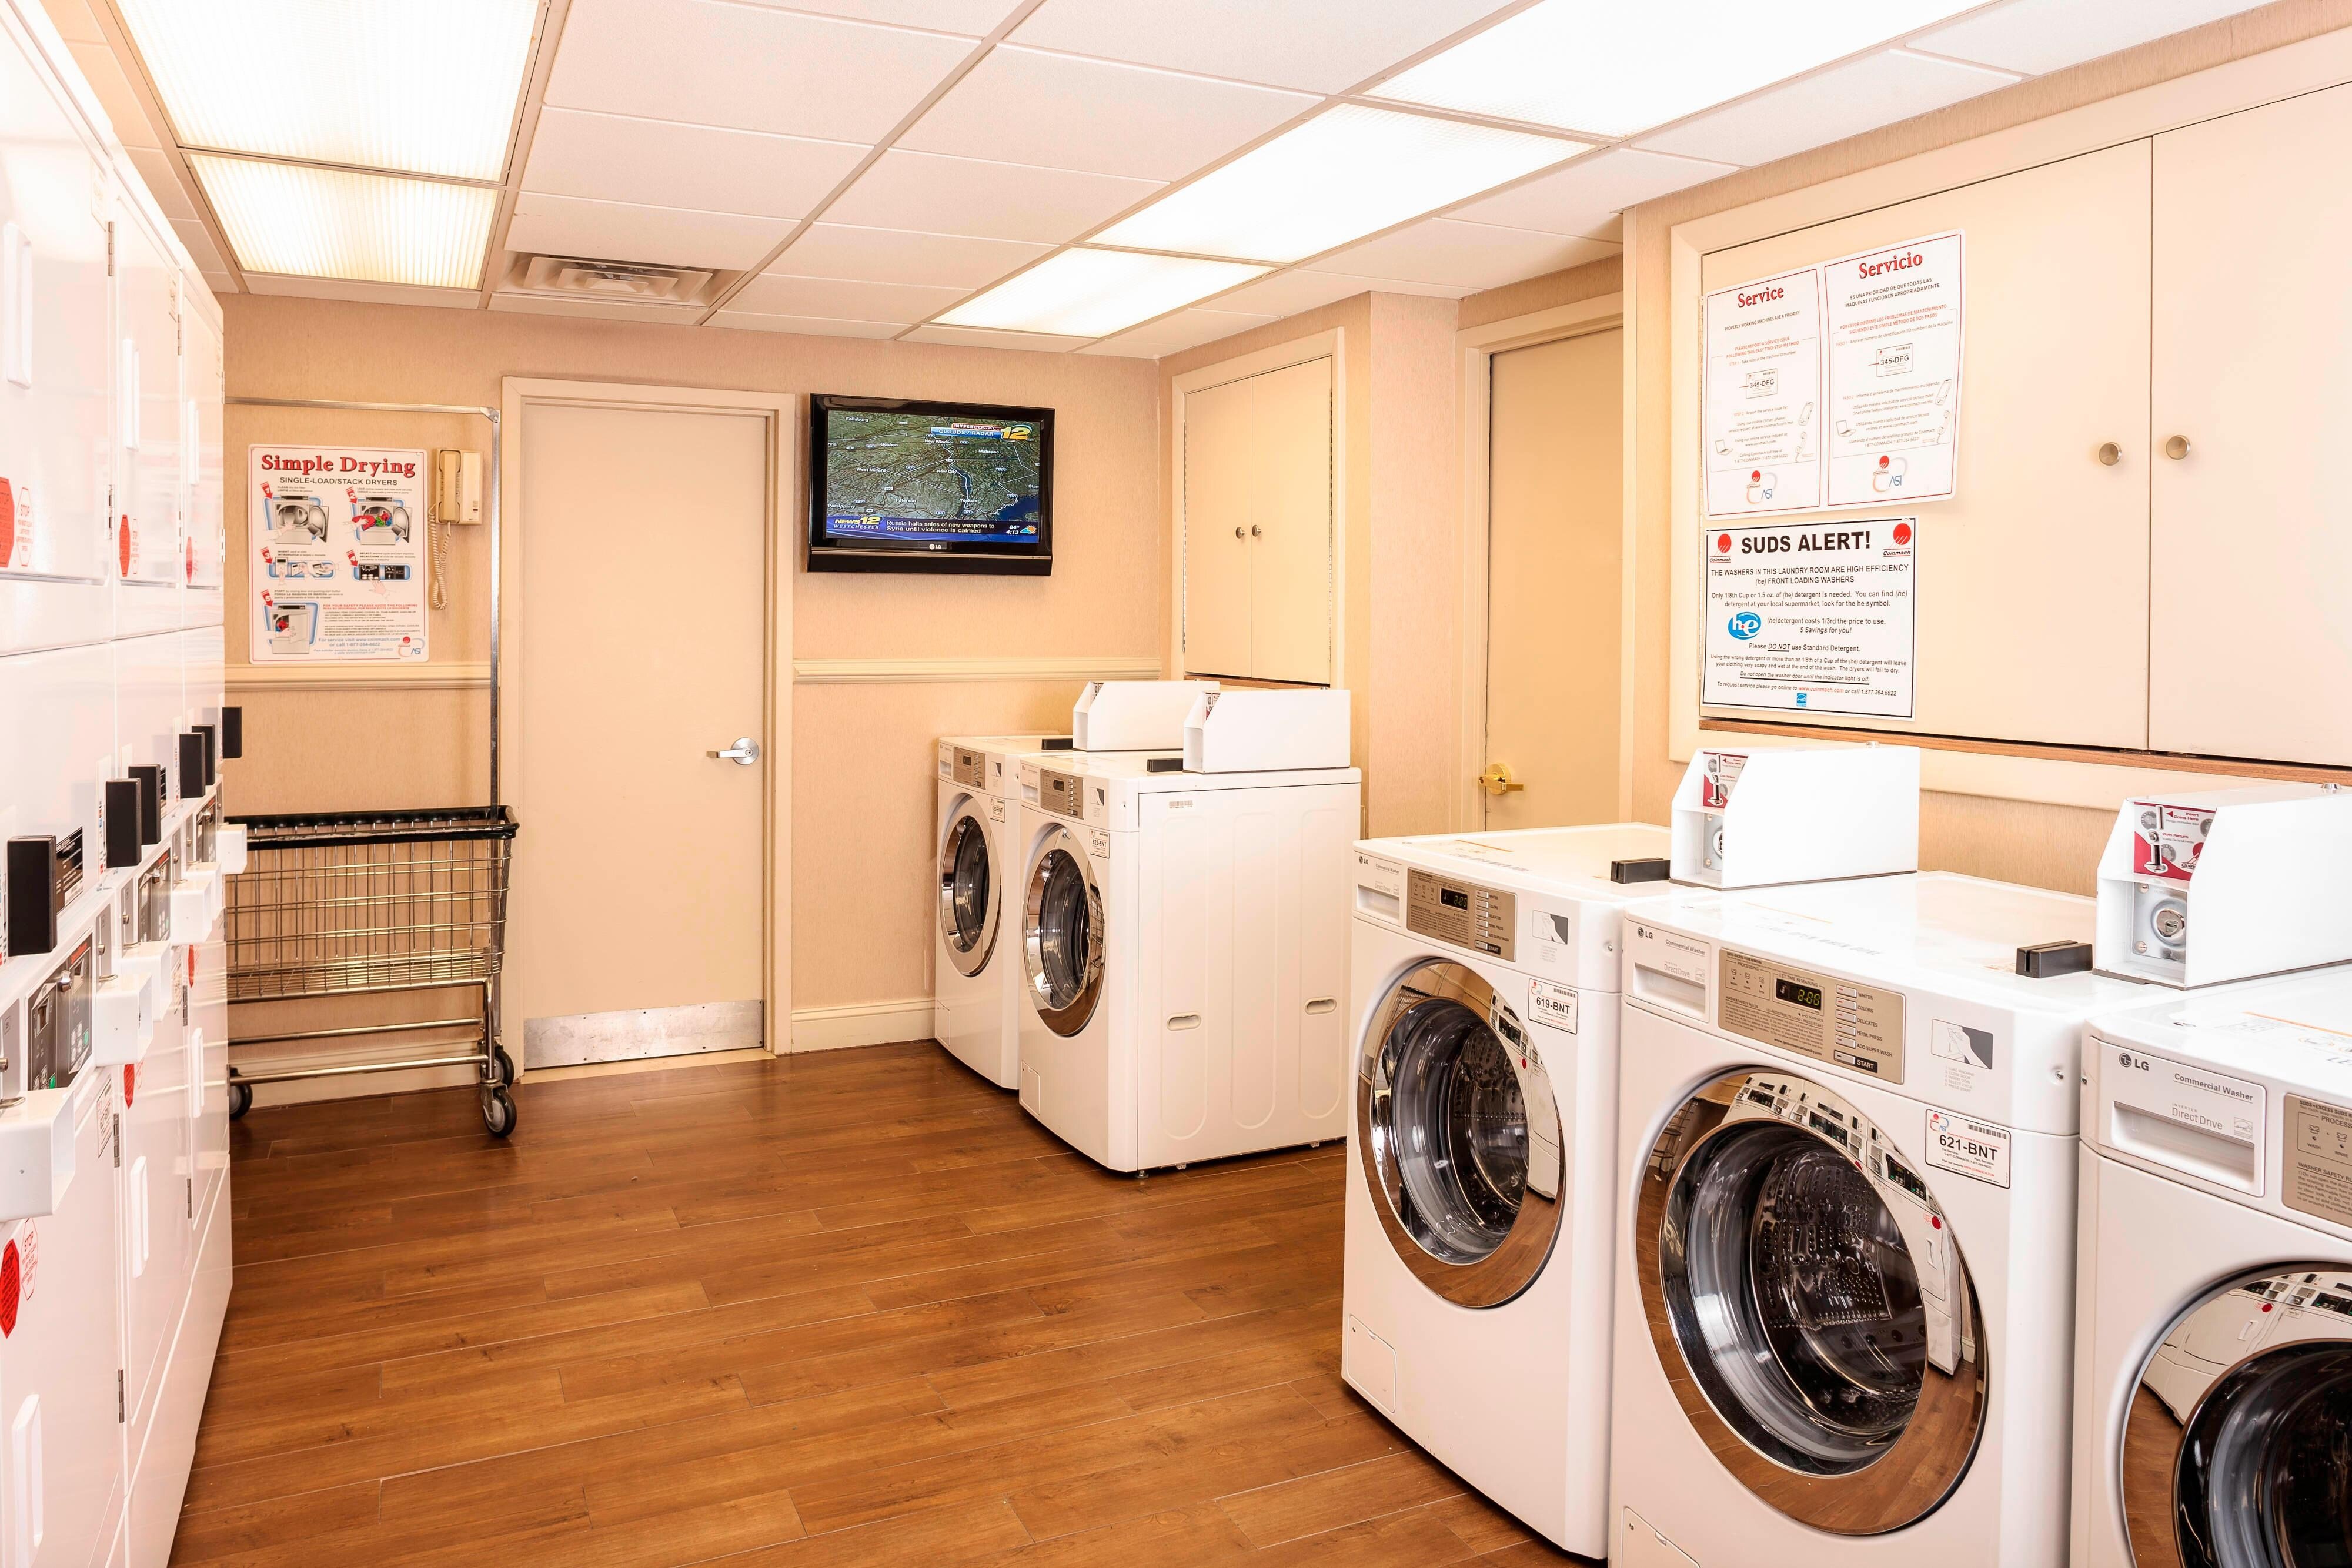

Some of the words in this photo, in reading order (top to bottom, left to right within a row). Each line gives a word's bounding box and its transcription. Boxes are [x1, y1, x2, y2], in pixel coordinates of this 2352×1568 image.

[1859, 252, 1923, 279] Servicio
[1738, 287, 1784, 308] Service
[1866, 287, 1889, 296] PRIORIDAD
[1869, 293, 1893, 303] FUNCIONEN
[1895, 283, 1940, 296] APROPRIADAMENTE
[1880, 355, 1909, 365] 345-DFG
[1750, 379, 1774, 388] 345-DFG
[1003, 427, 1030, 440] 12
[262, 455, 333, 475] Simple
[340, 457, 415, 477] Drying
[280, 477, 363, 485] SINGLE-LOAD/STACK
[1742, 536, 1790, 553] SUDS
[1798, 531, 1870, 551] ALERT!
[1645, 931, 1653, 939] LG
[1666, 939, 1689, 950] Commercial
[1690, 945, 1705, 955] Washer
[1737, 962, 1759, 971] PROCESSING
[1536, 997, 1570, 1014] 619-BNT
[1857, 1018, 1878, 1027] DELICATES
[1870, 1033, 1882, 1041] PRESS
[1866, 1045, 1880, 1054] SUPER
[1857, 1061, 1875, 1069] START
[2134, 1059, 2149, 1071] LG
[2174, 1073, 2220, 1092] Commercial
[2223, 1086, 2253, 1101] Washer
[2172, 1108, 2199, 1124] Direct
[2200, 1116, 2223, 1130] Drive
[1939, 1135, 1998, 1161] 621-BNT
[2298, 1162, 2323, 1173] WASHER
[2323, 1169, 2344, 1180] SAFETY
